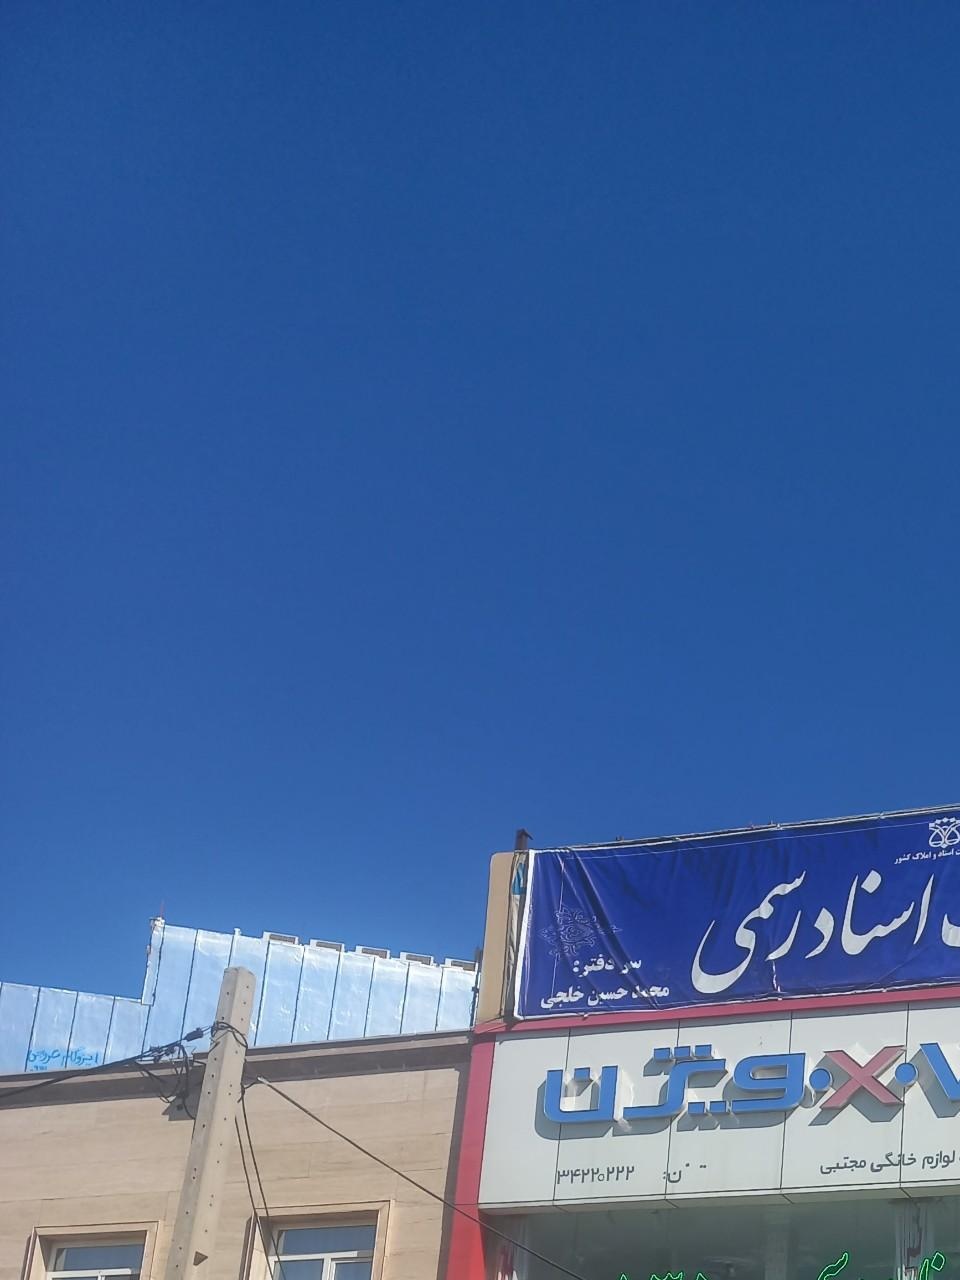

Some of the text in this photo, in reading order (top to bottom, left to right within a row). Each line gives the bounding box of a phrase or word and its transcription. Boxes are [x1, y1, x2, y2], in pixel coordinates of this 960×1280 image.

[804, 869, 934, 960] اسناد
[690, 869, 807, 995] رسمی
[540, 985, 585, 1009] خلجی
[587, 985, 629, 1007] حسین
[819, 1156, 867, 1175] مجتبی
[869, 1151, 917, 1173] خانگی
[921, 1149, 956, 1170] لوازم
